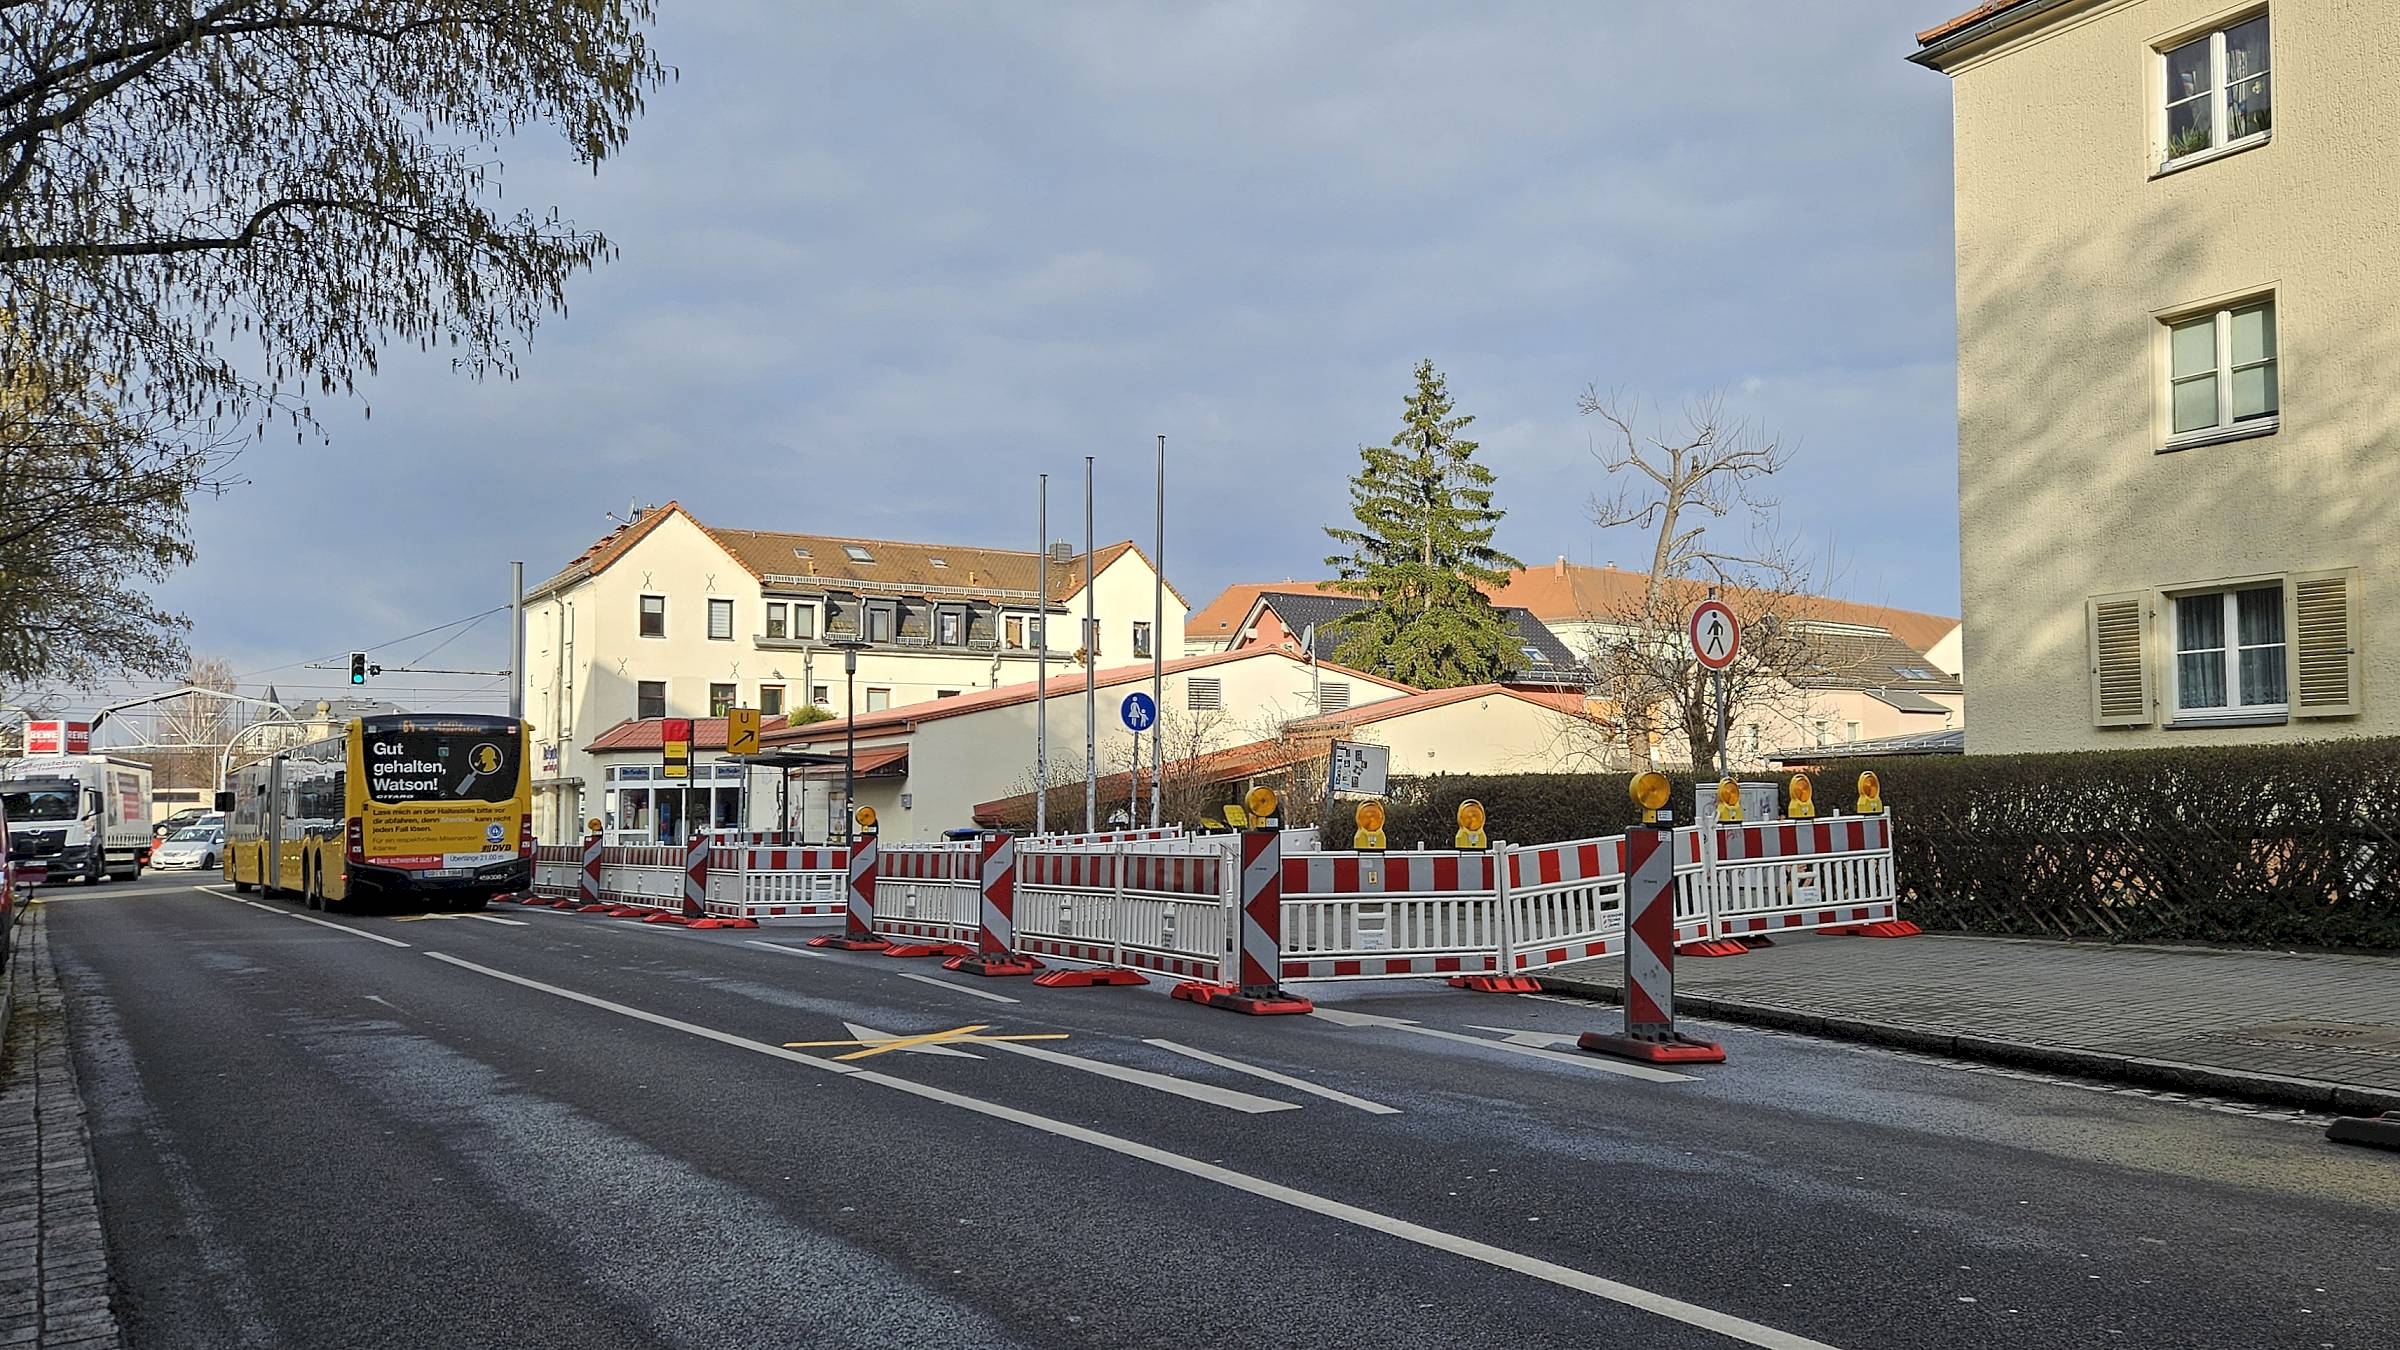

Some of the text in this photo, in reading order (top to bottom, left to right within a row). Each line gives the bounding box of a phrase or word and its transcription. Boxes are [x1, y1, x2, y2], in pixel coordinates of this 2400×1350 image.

[740, 712, 750, 724] U
[30, 730, 59, 739] REWE
[67, 731, 89, 739] REWE
[373, 742, 404, 756] Gut
[373, 759, 447, 776] gehalten,
[373, 778, 439, 792] Watson!
[423, 807, 436, 815] der
[438, 807, 476, 815] Haltestelle
[477, 806, 493, 814] bitte
[384, 816, 420, 824] abfahren,
[421, 816, 441, 824] denn
[493, 814, 512, 822] nicht
[372, 826, 394, 834] jeden
[395, 825, 409, 833] Fall
[372, 836, 384, 844] Für
[492, 844, 512, 852] DVB
[376, 857, 389, 865] Bus
[389, 857, 418, 865] schwenkt
[449, 855, 479, 864] Überlänge
